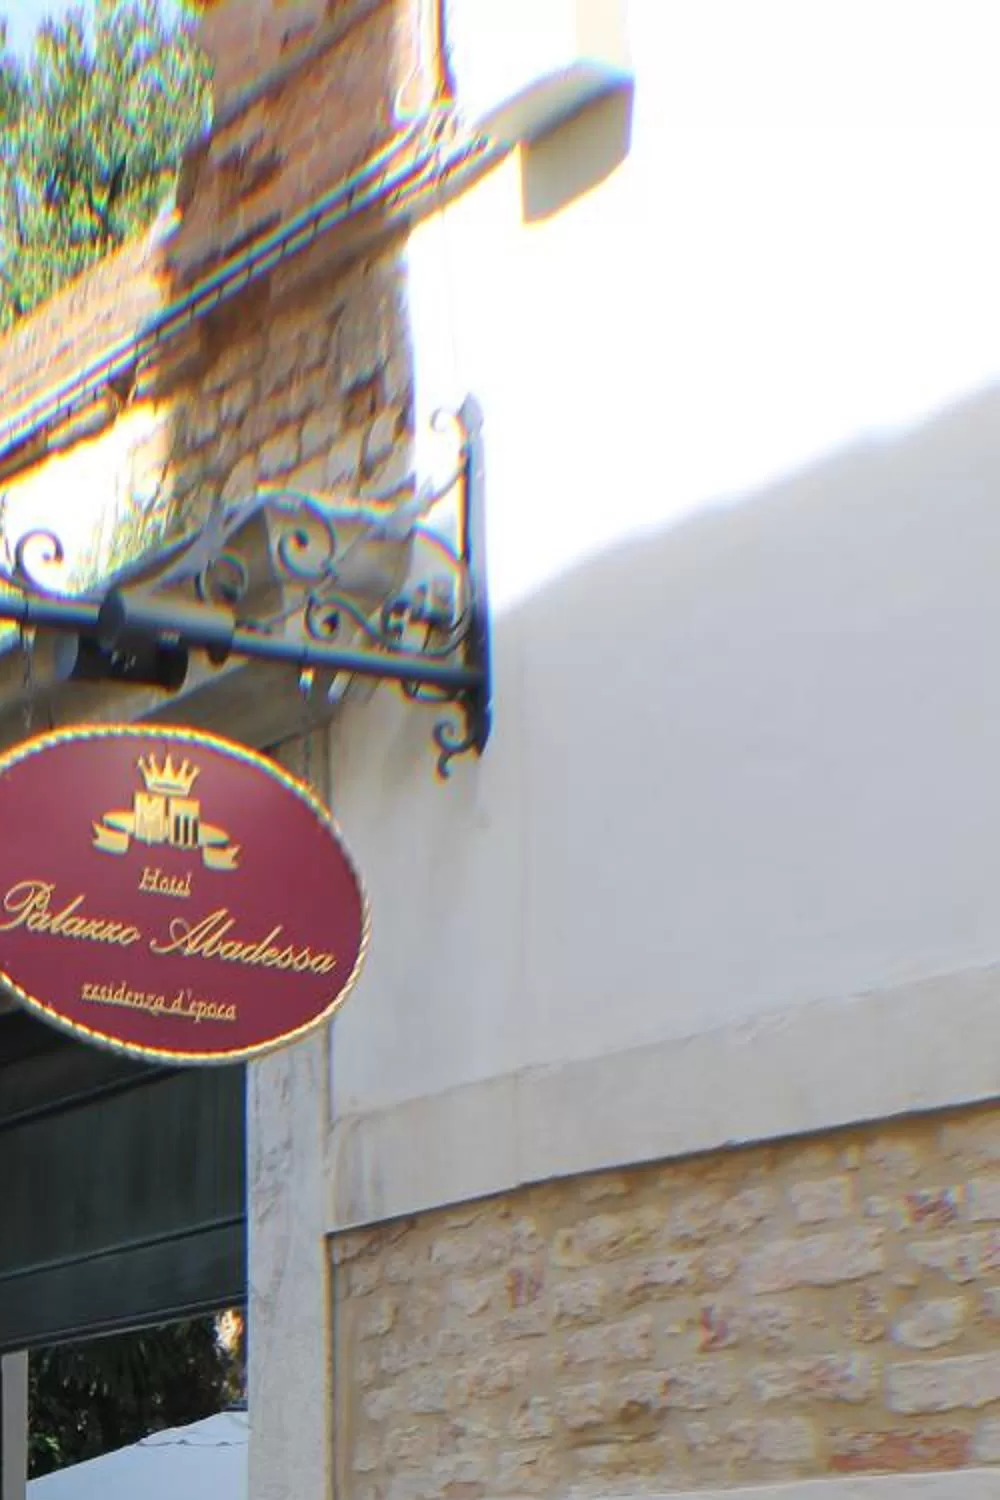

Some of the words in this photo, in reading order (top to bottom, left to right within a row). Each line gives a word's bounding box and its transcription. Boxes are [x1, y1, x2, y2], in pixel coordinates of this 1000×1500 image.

[138, 867, 192, 897] Hotel
[151, 908, 337, 975] Abadessa
[81, 979, 165, 1016] residenza
[171, 987, 237, 1025] d'epoca
